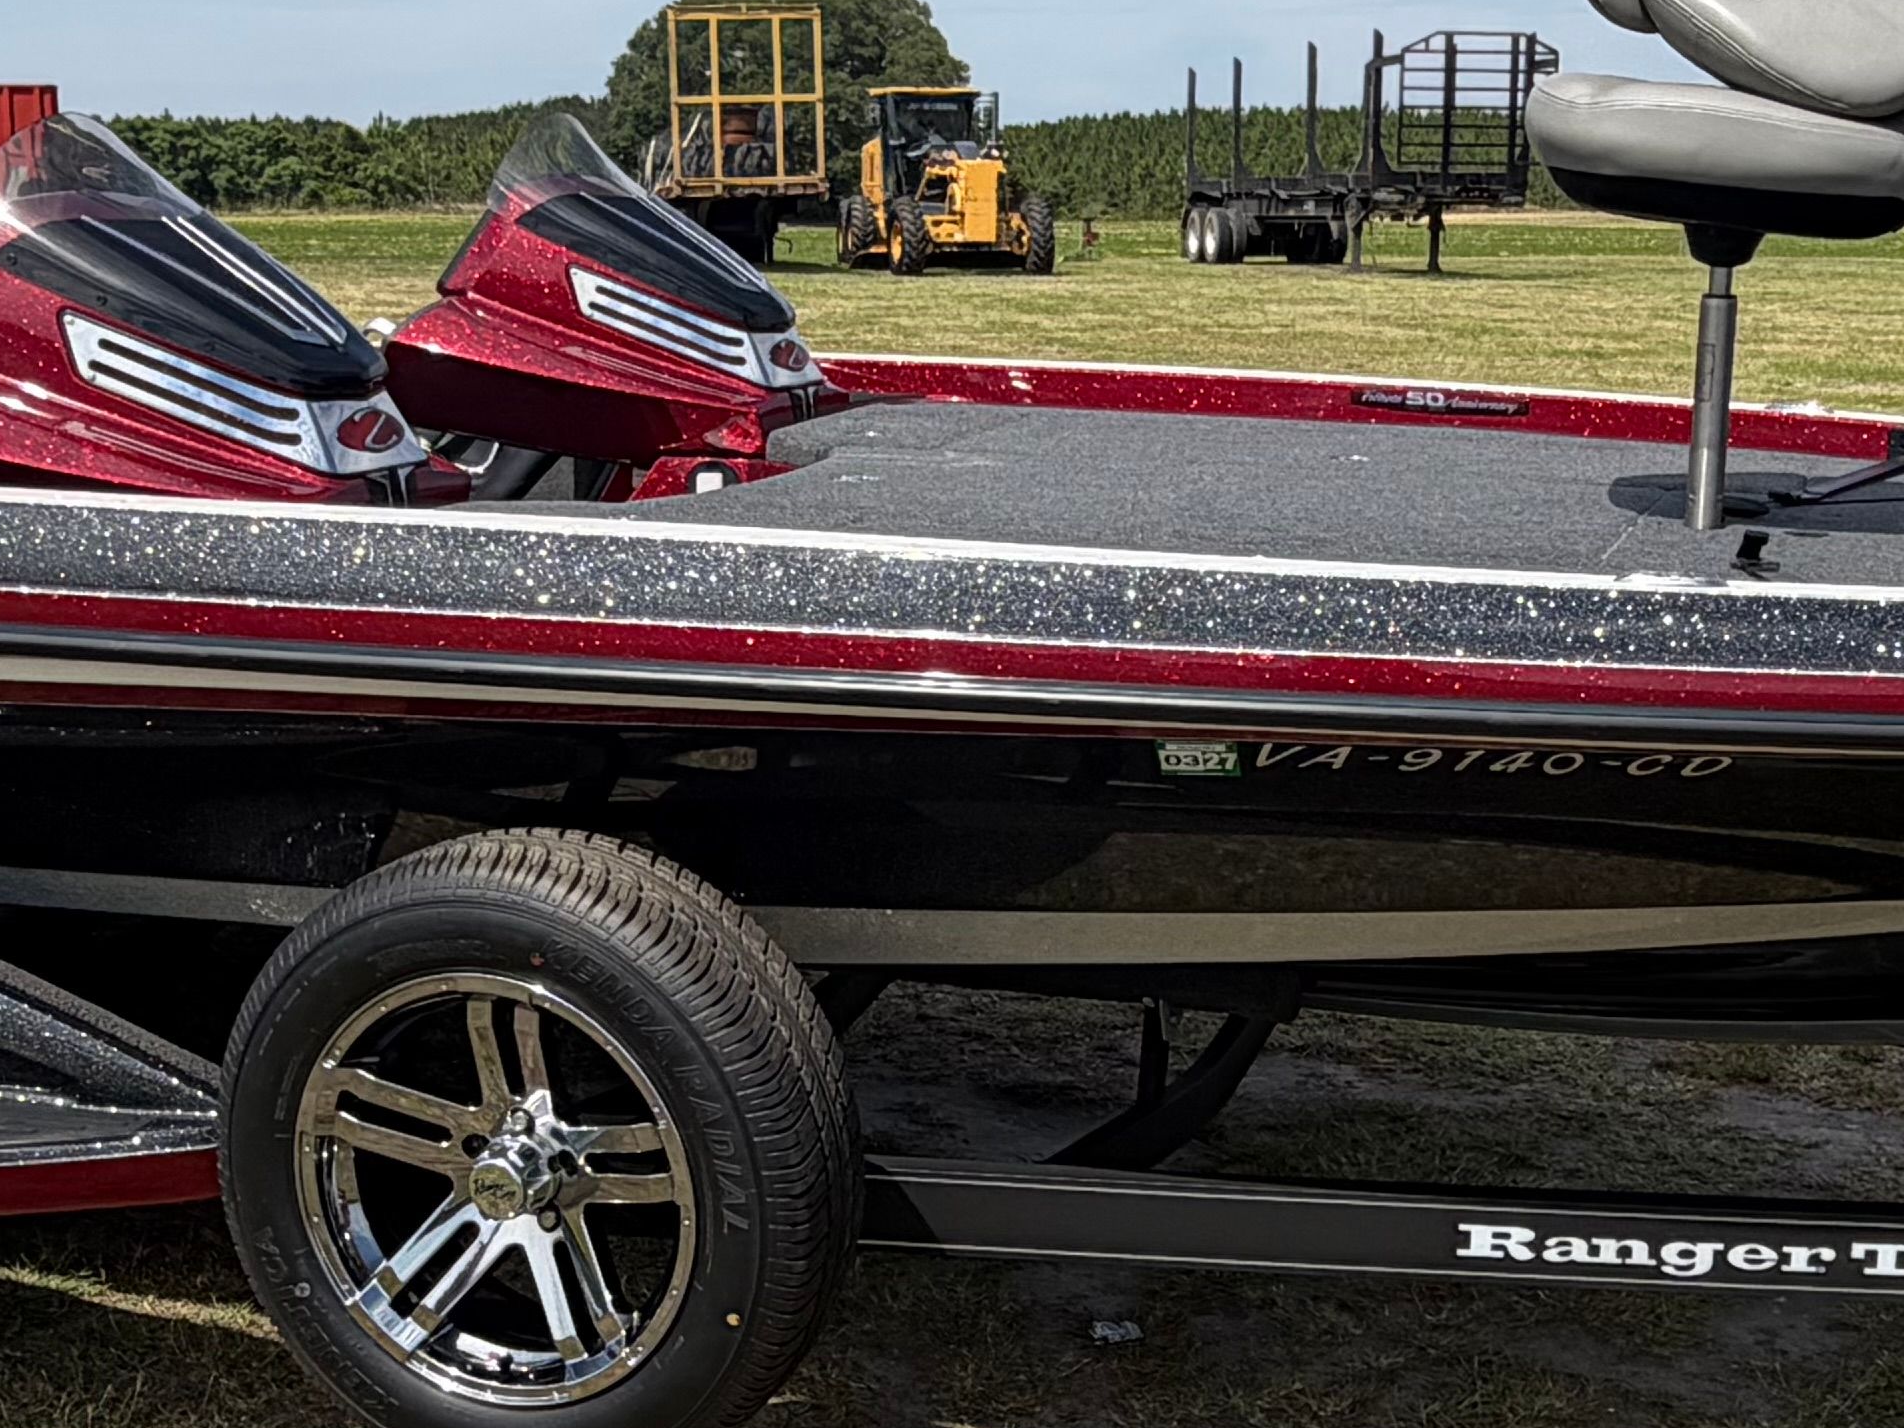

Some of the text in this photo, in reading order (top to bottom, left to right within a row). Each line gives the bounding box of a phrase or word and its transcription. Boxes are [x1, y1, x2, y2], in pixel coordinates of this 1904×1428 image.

[541, 938, 752, 1236] KENDA RADIAL
[1455, 1222, 1837, 1277] Ranger
